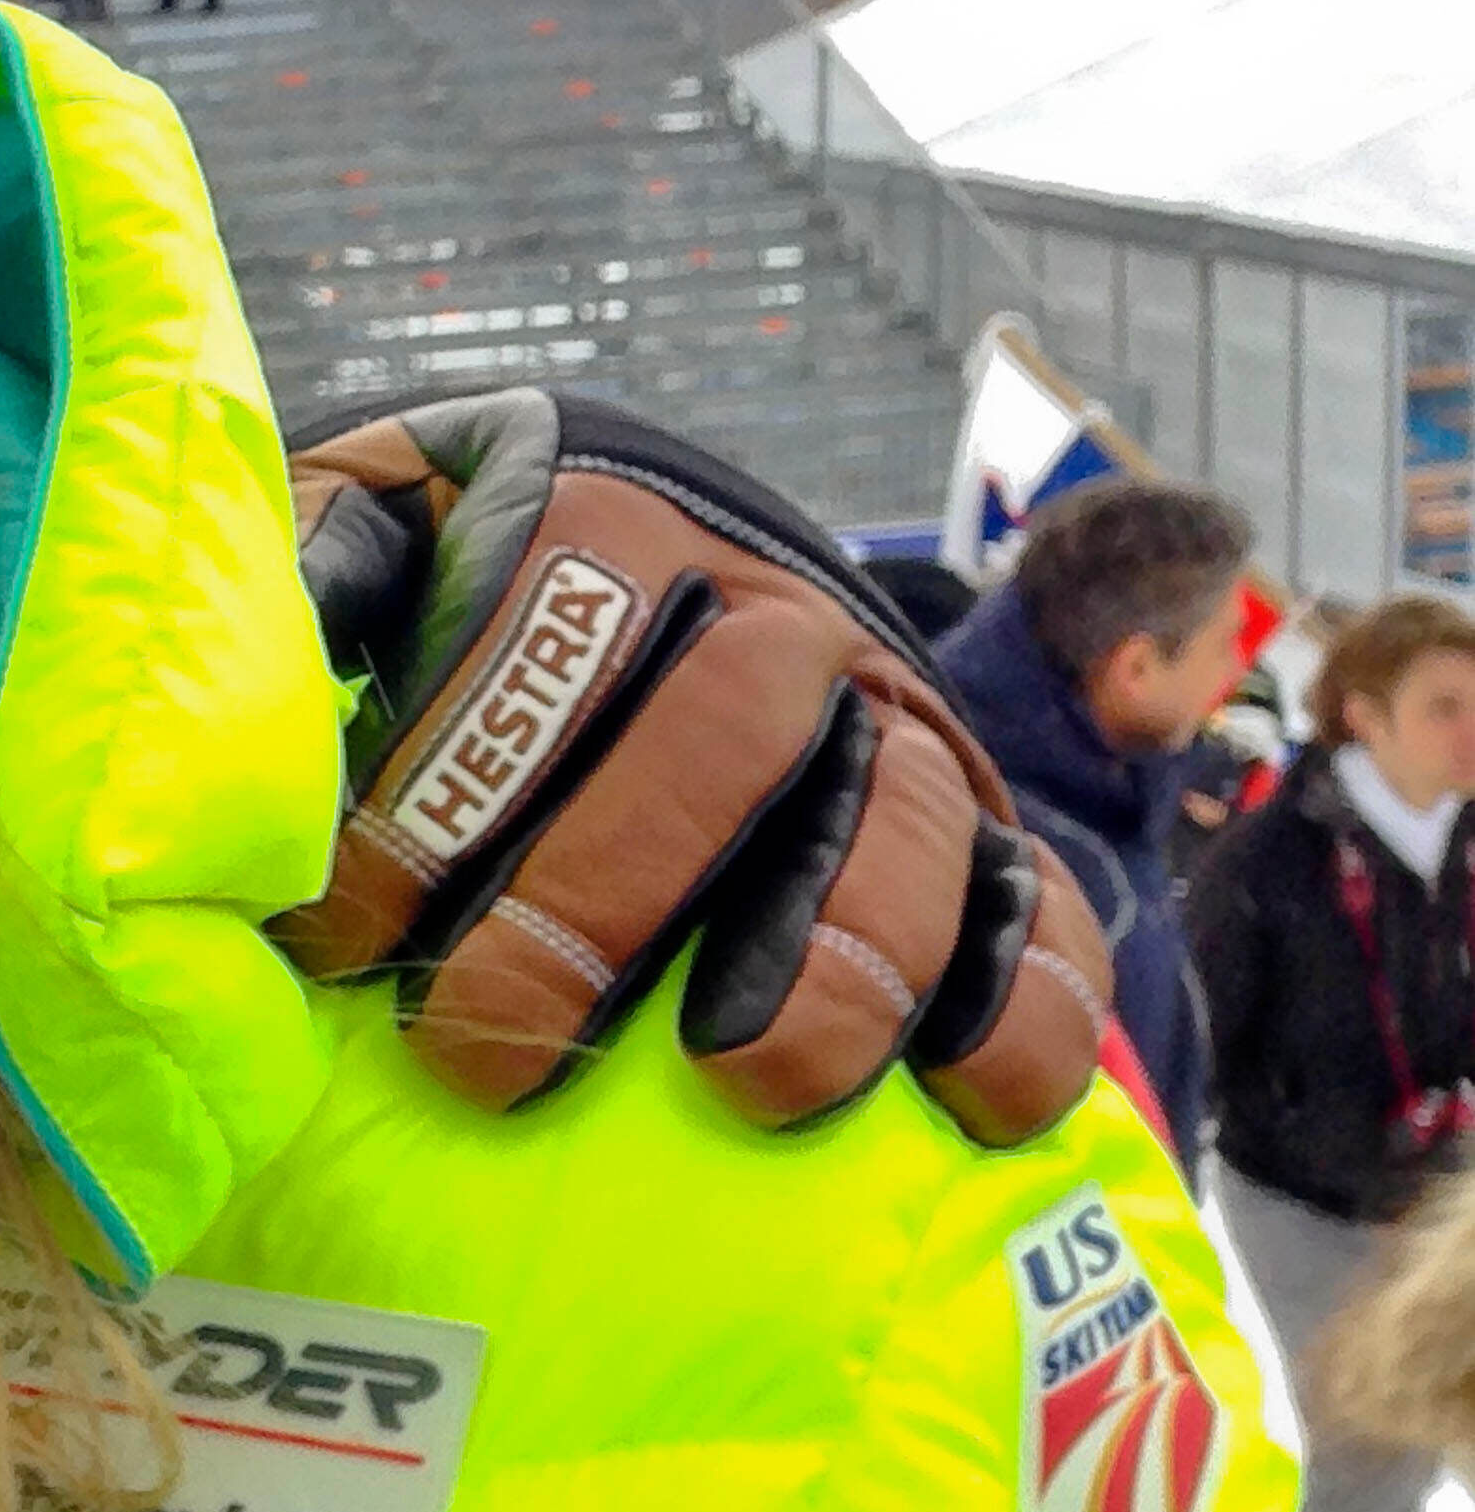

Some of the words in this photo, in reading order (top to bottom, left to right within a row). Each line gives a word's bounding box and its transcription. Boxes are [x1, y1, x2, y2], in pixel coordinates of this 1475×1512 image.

[412, 587, 614, 842] HESTRA
[1022, 1203, 1121, 1310] US
[99, 1304, 442, 1431] DER
[1042, 1319, 1098, 1386] SKI
